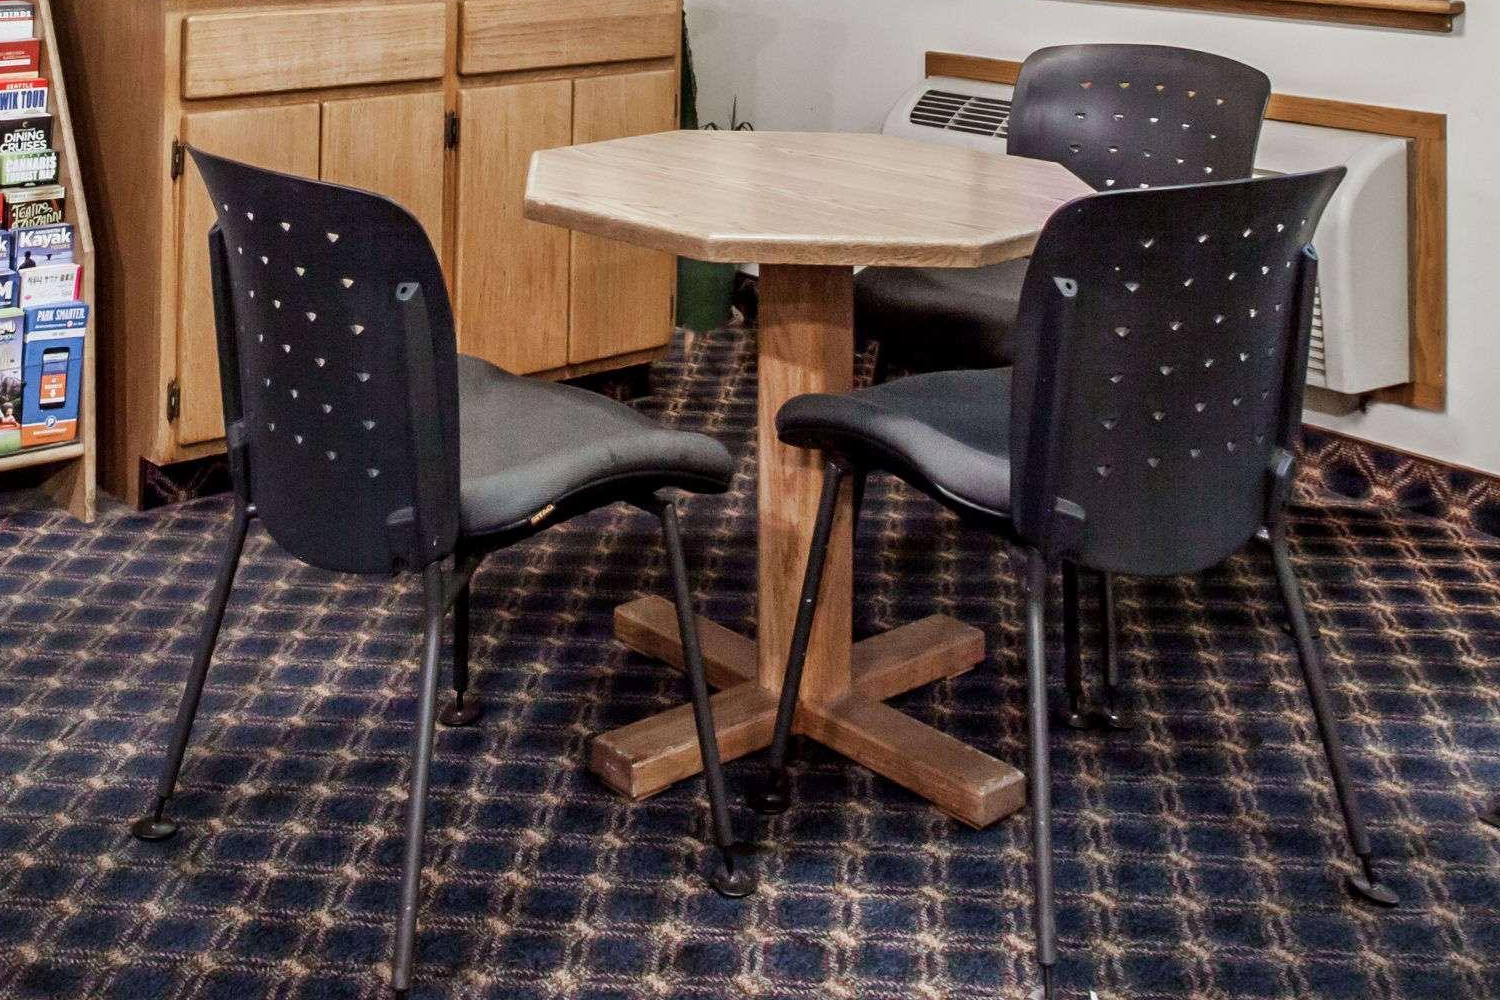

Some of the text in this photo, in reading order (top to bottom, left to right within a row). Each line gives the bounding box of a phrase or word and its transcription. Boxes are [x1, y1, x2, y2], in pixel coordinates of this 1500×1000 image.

[21, 90, 45, 108] TOUR
[4, 130, 44, 142] DINING
[0, 139, 47, 152] CRUISES
[19, 227, 71, 248] Kayak
[37, 309, 54, 321] PARK
